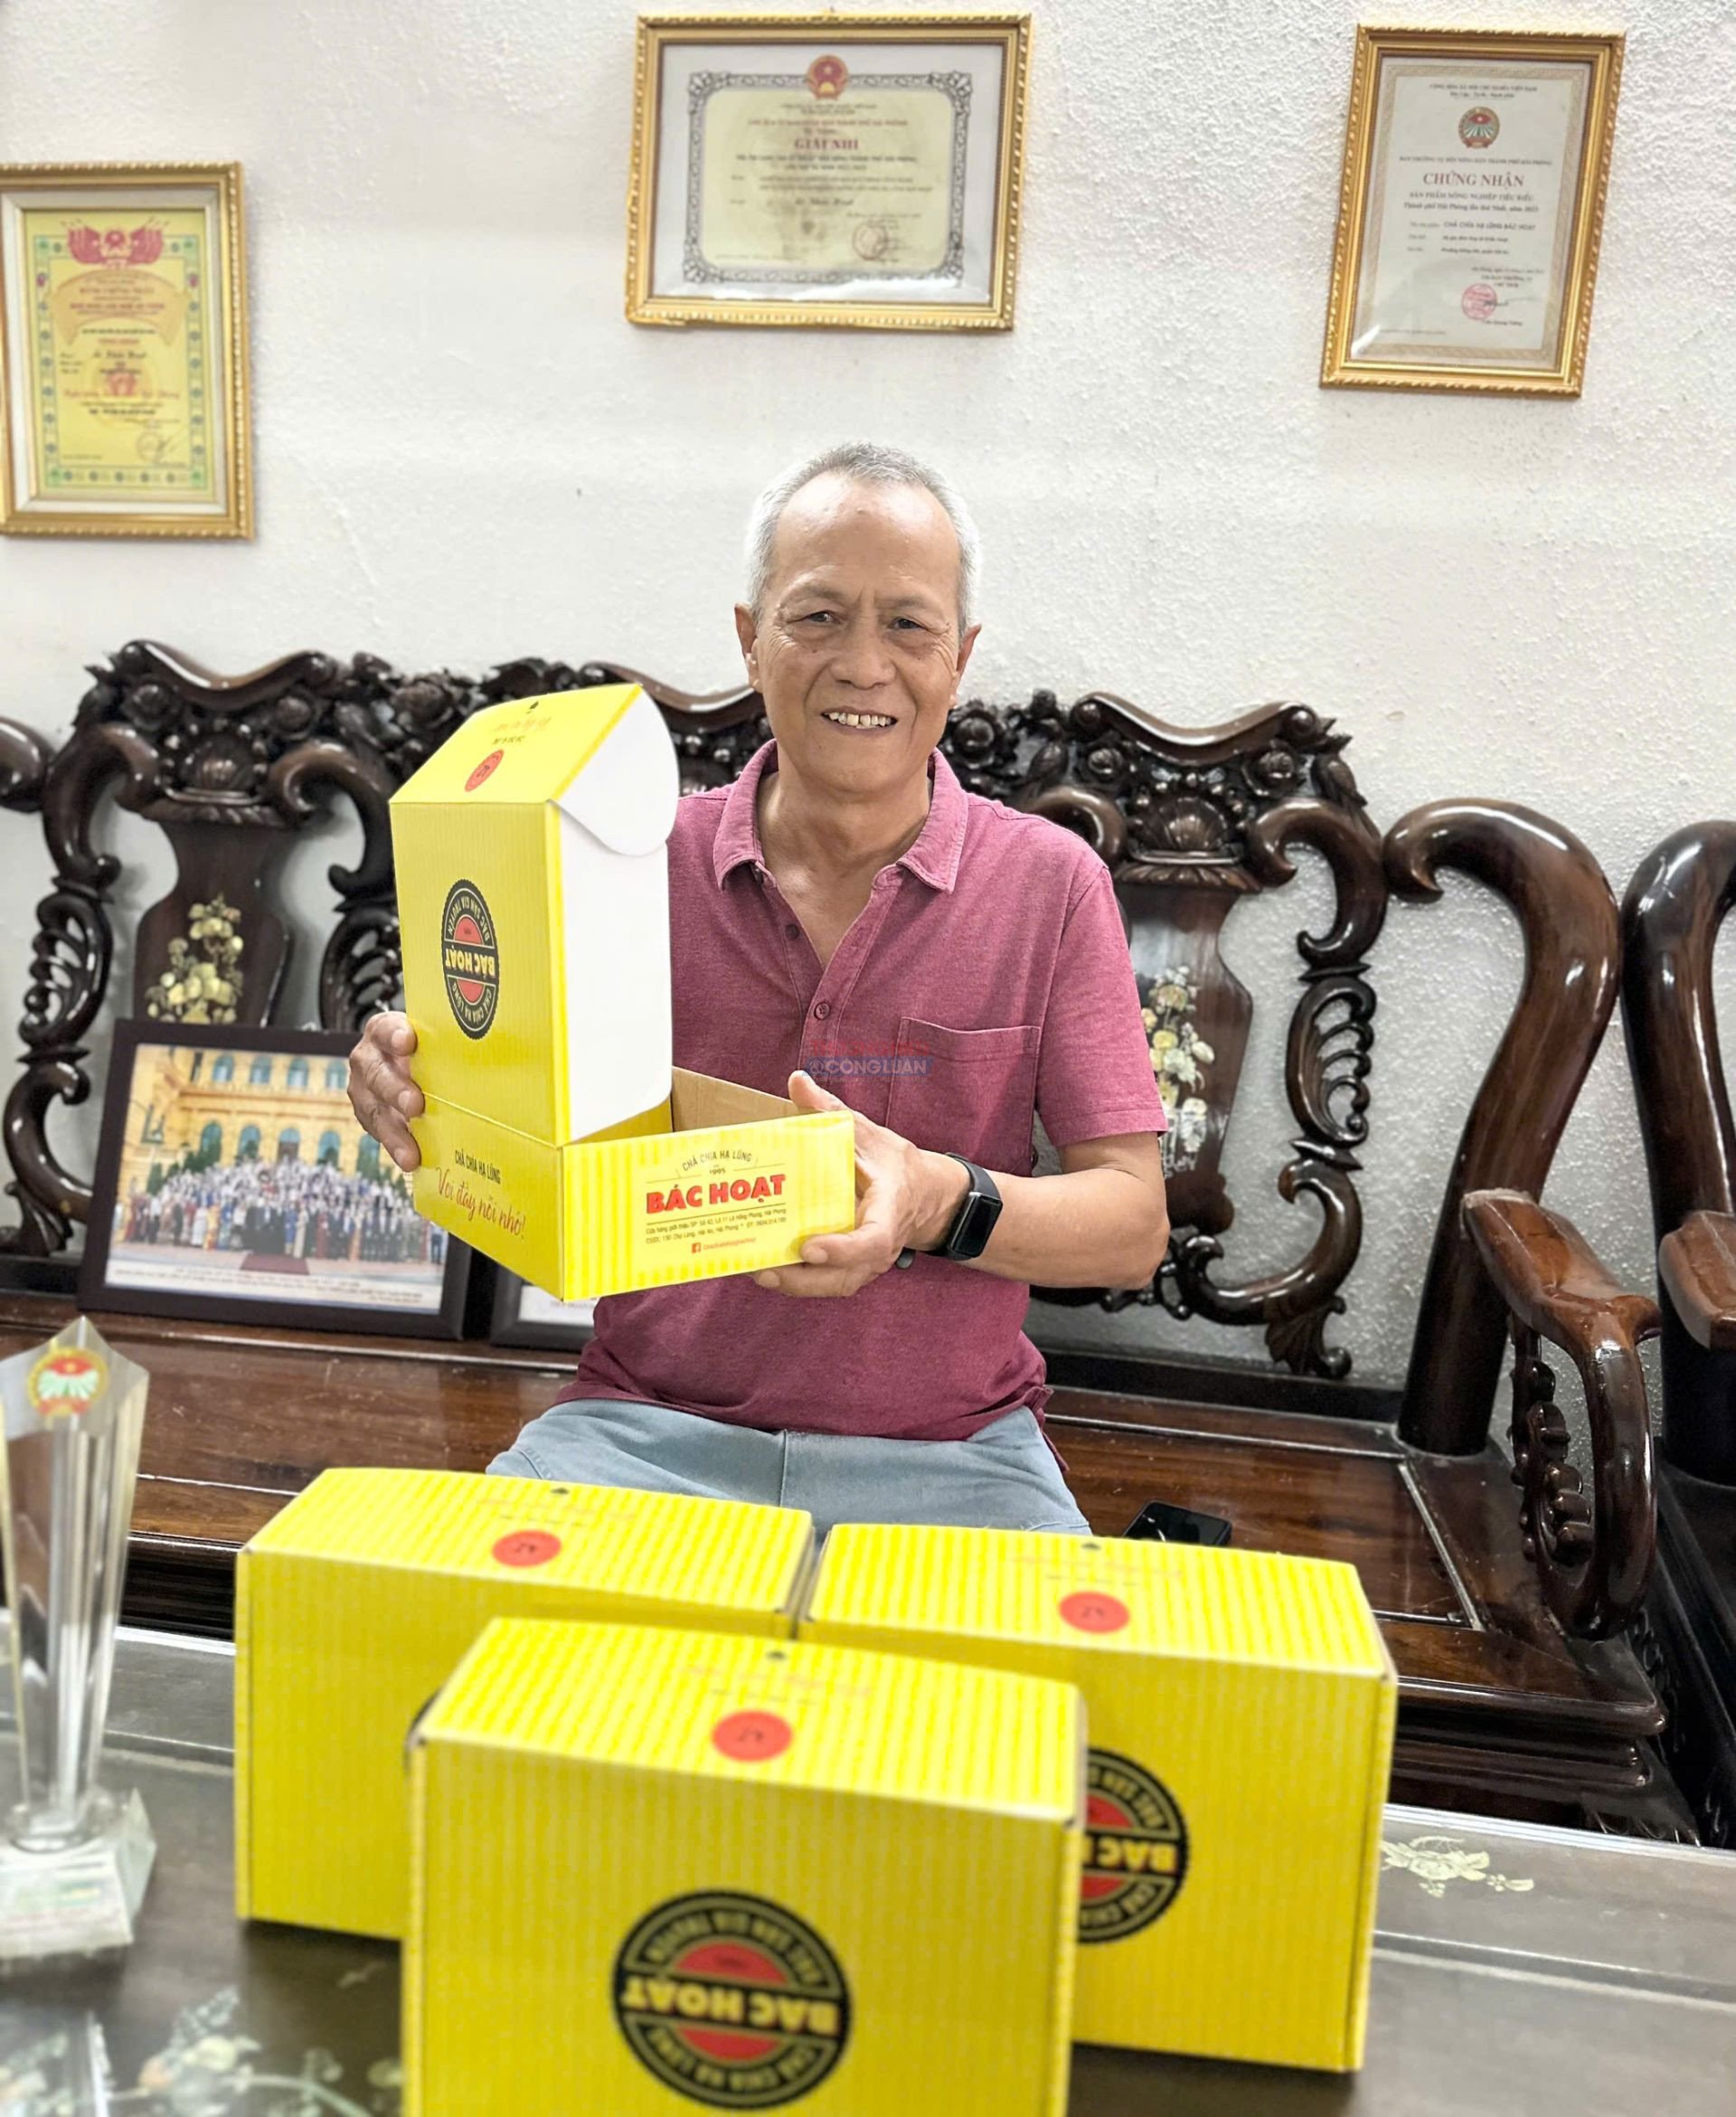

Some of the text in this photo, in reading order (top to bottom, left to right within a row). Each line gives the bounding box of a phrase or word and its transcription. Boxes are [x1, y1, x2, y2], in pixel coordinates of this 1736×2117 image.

[1423, 169, 1525, 190] CHỨNG NHẬN
[445, 945, 495, 979] BÁC HOẠT
[646, 1174, 786, 1214] BÁC HOẠT
